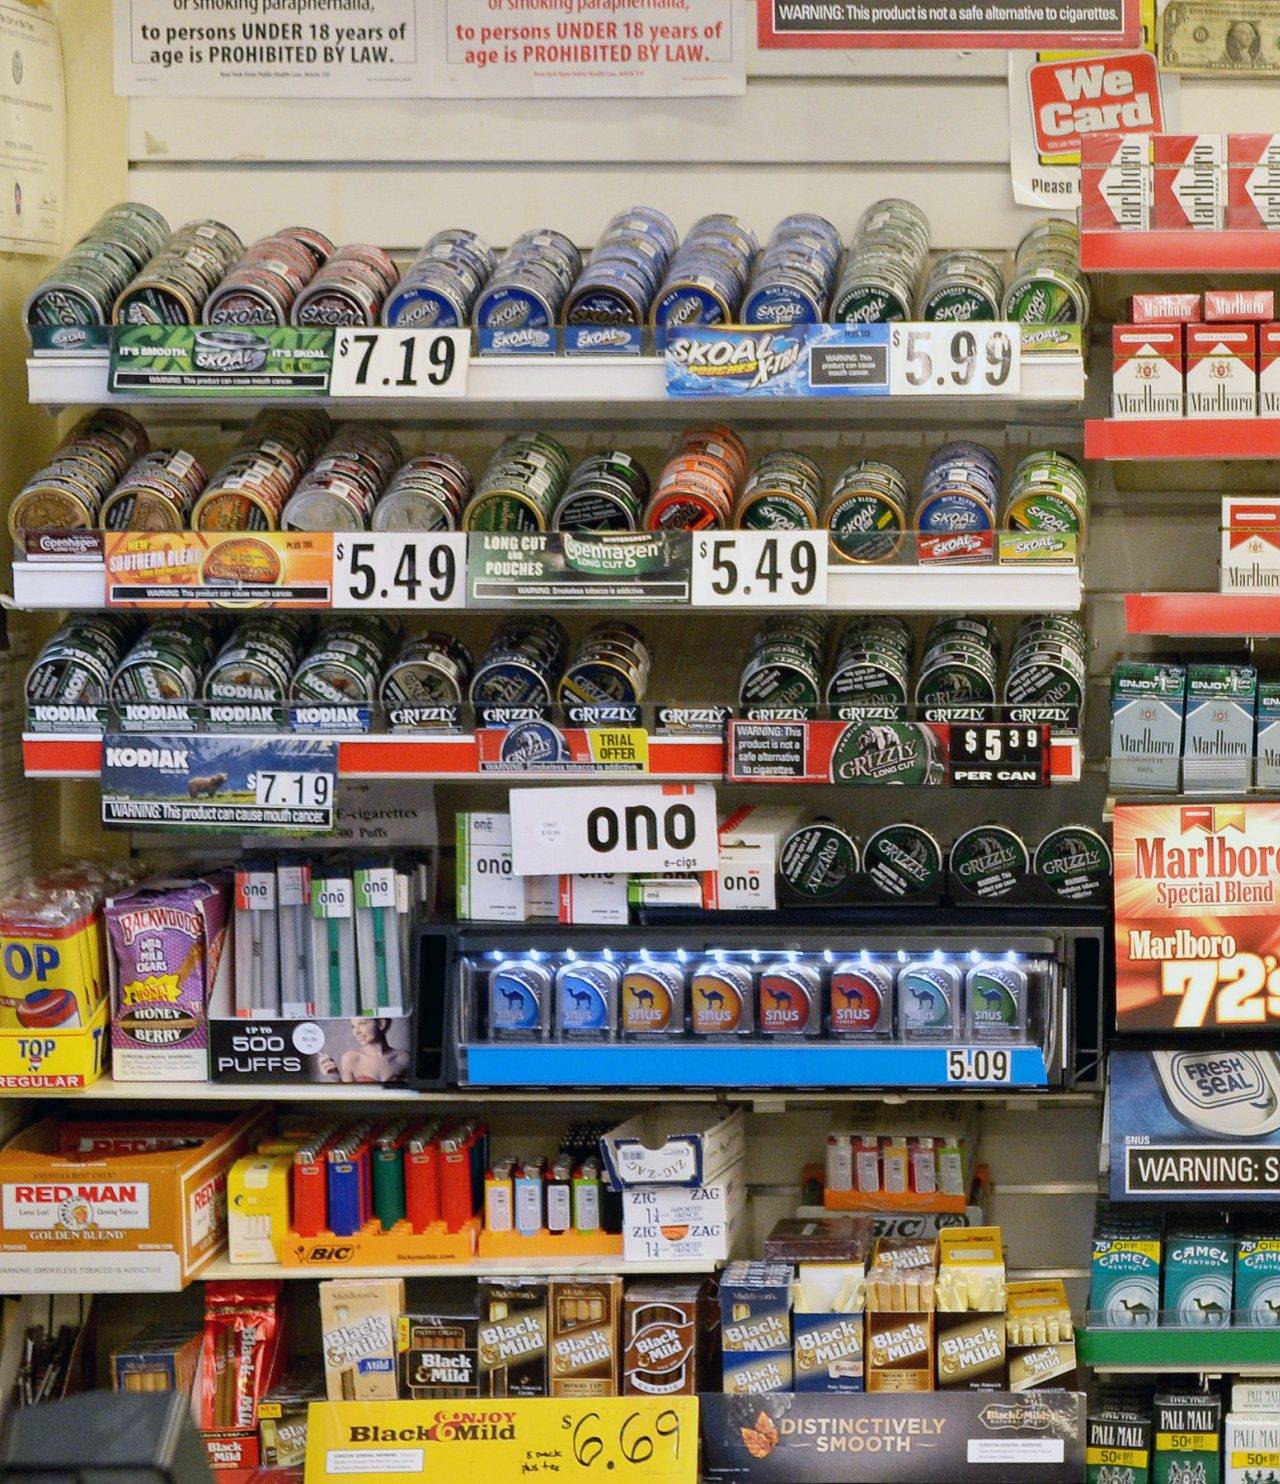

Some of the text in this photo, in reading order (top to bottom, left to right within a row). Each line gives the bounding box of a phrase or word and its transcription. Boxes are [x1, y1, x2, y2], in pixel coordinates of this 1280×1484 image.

[779, 5, 1118, 22] WARNING: This product is not a safe alternative to cigarettes.
[142, 23, 408, 43] to persons UNDER 18 years of
[150, 47, 394, 67] age is PROHIBITED BY LAW.
[1055, 64, 1133, 101] We
[1040, 94, 1153, 136] Card
[1032, 178, 1072, 194] Please
[119, 347, 187, 357] IT'S SMOOTH.
[272, 349, 329, 358] IT'S SKOAL.
[339, 334, 456, 386] $7.19
[672, 335, 774, 366] SKOAL
[892, 330, 1012, 387] $5.99
[1115, 392, 1180, 414] Marlboro
[484, 537, 547, 550] LONG CUT
[563, 533, 661, 568] Copenhagen
[336, 543, 457, 600] $5.49
[486, 562, 543, 576] POUCHES
[700, 539, 817, 595] $5.49
[35, 707, 98, 722] KODIAK
[389, 704, 457, 725] GRIZZLY
[1010, 708, 1071, 722] GRIZZLY
[600, 734, 634, 746] TRIAL
[737, 727, 801, 737] WARNING: This
[1119, 726, 1174, 755] Marlboro
[106, 748, 189, 769] KODIAK
[600, 748, 635, 760] OFFER
[738, 752, 800, 761] safe alternative
[839, 740, 916, 780] GRIZZLY
[954, 771, 1036, 781] PER CAN
[247, 773, 328, 804] $7.19
[111, 804, 324, 824] WARNING: This product can cause mouth cancer.
[587, 803, 696, 853] ono
[664, 858, 697, 868] e-cigs
[1156, 880, 1274, 909] Special Blend
[118, 909, 201, 945] BACKWOODS
[1128, 929, 1236, 961] Marlboro
[134, 1029, 182, 1043] BERRY
[232, 1036, 285, 1053] 500
[18, 1039, 56, 1058] TOP
[218, 1057, 301, 1073] PUFFS
[948, 1050, 1008, 1080] 5.09
[0, 1076, 80, 1088] REGULAR
[1125, 1135, 1150, 1145] SNUS
[1138, 1158, 1260, 1183] WARNING:
[15, 1186, 136, 1203] RED MAN
[632, 1188, 719, 1204] ZIG ZAG
[32, 1231, 123, 1240] GOLDEN BLEND
[1114, 1241, 1138, 1251] OFF
[1171, 1246, 1230, 1263] CAMEL
[421, 1353, 472, 1369] Black
[779, 1417, 946, 1436] DISTINCTIVELY
[1091, 1425, 1144, 1447] PALL MALL
[561, 1410, 680, 1468] $6.69
[815, 1435, 912, 1454] SMOOTH
